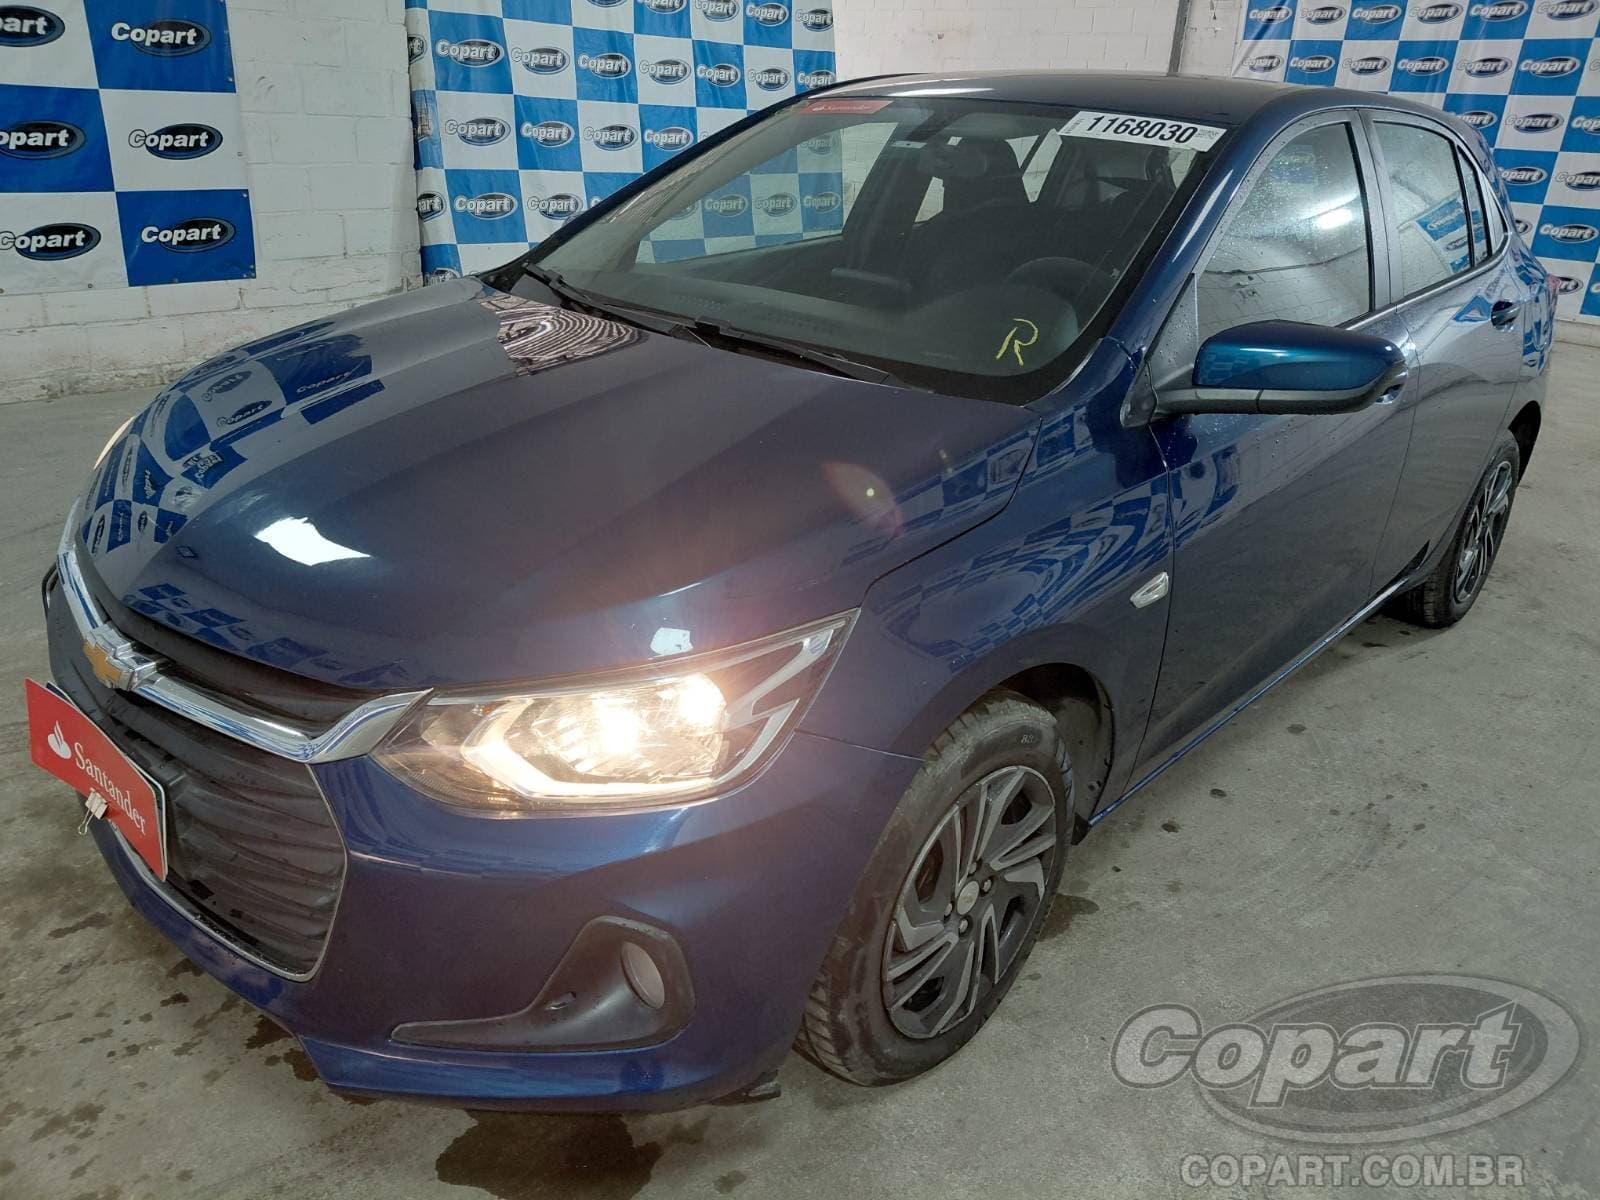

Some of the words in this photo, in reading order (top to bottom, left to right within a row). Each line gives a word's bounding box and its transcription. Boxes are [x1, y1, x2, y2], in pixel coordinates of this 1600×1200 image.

[746, 5, 784, 20] Copart
[1250, 8, 1286, 20] Copart
[1300, 8, 1341, 20] Copart
[1353, 7, 1397, 19] Copart
[1410, 7, 1454, 19] Copart
[1471, 4, 1519, 18] Copart
[1537, 2, 1590, 15] Copart
[796, 10, 832, 25] Copart
[0, 16, 48, 35] art
[110, 22, 197, 46] Copart
[436, 40, 497, 61] Copart
[512, 47, 562, 67] Copart
[578, 54, 627, 73] Copart
[640, 60, 684, 78] Copart
[1243, 57, 1278, 69] Copart
[1291, 57, 1330, 69] Copart
[1342, 58, 1385, 71] Copart
[1398, 59, 1442, 72] Copart
[1457, 59, 1505, 73] Copart
[1520, 59, 1575, 74] Copart
[697, 65, 736, 81] Copart
[748, 69, 786, 84] Copart
[797, 72, 832, 86] Copart
[445, 119, 502, 138] Copart
[1505, 114, 1557, 130] Copart
[1571, 116, 1600, 131] Cop
[520, 122, 569, 140] Copart
[584, 127, 631, 142] Copart
[644, 129, 688, 145] Copart
[1087, 116, 1198, 144] 1168030
[0, 129, 70, 149] opart
[128, 129, 209, 151] Copart
[1501, 170, 1540, 183] opart
[1556, 171, 1600, 186] Copar
[455, 196, 511, 216] Copart
[527, 196, 575, 213] Copart
[705, 198, 743, 211] Copart
[755, 196, 792, 210] Copart
[141, 223, 222, 245] Copart
[1540, 224, 1593, 240] Copart
[996, 318, 1039, 367] R
[74, 742, 146, 836] Santander
